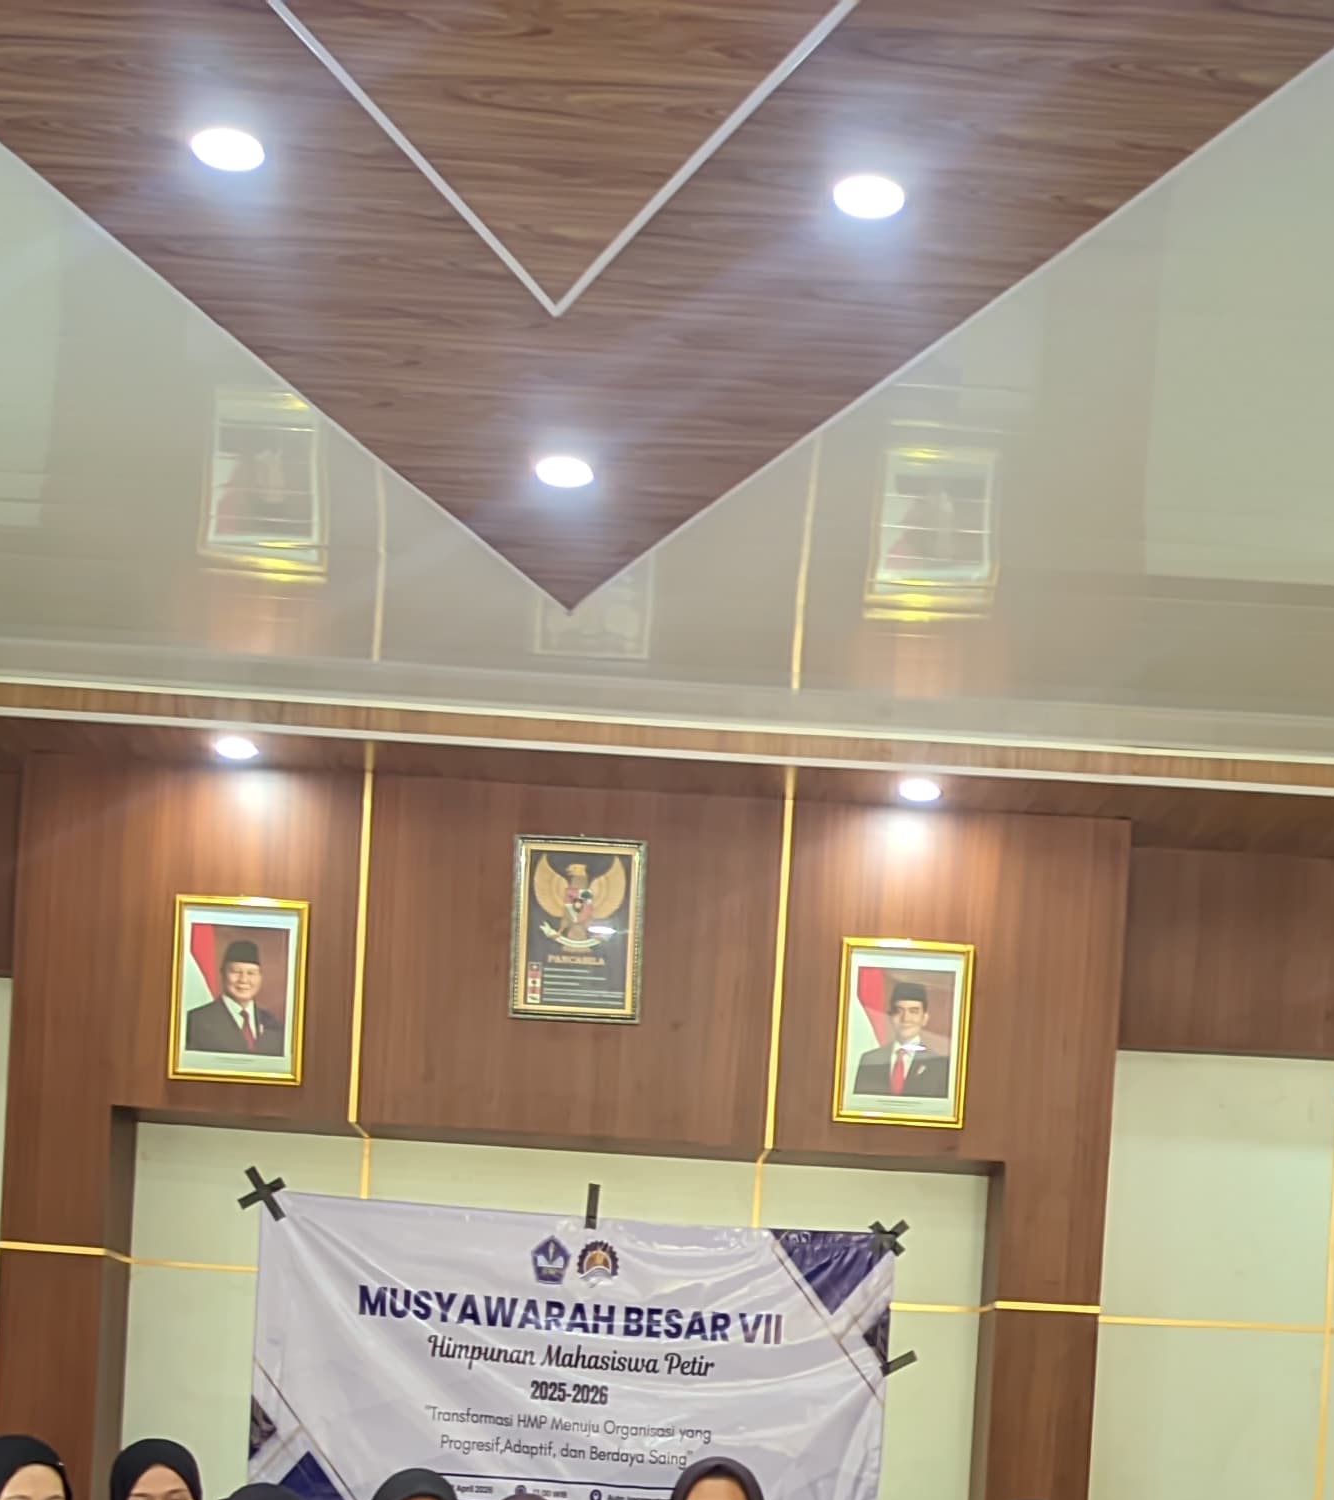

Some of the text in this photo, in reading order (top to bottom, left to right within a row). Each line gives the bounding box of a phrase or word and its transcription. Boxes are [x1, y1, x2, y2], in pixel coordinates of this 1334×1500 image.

[358, 1285, 783, 1345] MUSYAWARAH BESAR VII
[427, 1335, 715, 1377] Himpunan Mahasiswa Petir
[530, 1380, 609, 1405] 2025-2026
[517, 1414, 547, 1429] HMP
[550, 1417, 600, 1437] Menuju
[603, 1420, 675, 1440] Organisasi
[679, 1427, 712, 1444] yang
[560, 1443, 586, 1459] dan
[589, 1446, 645, 1467] Berdaya
